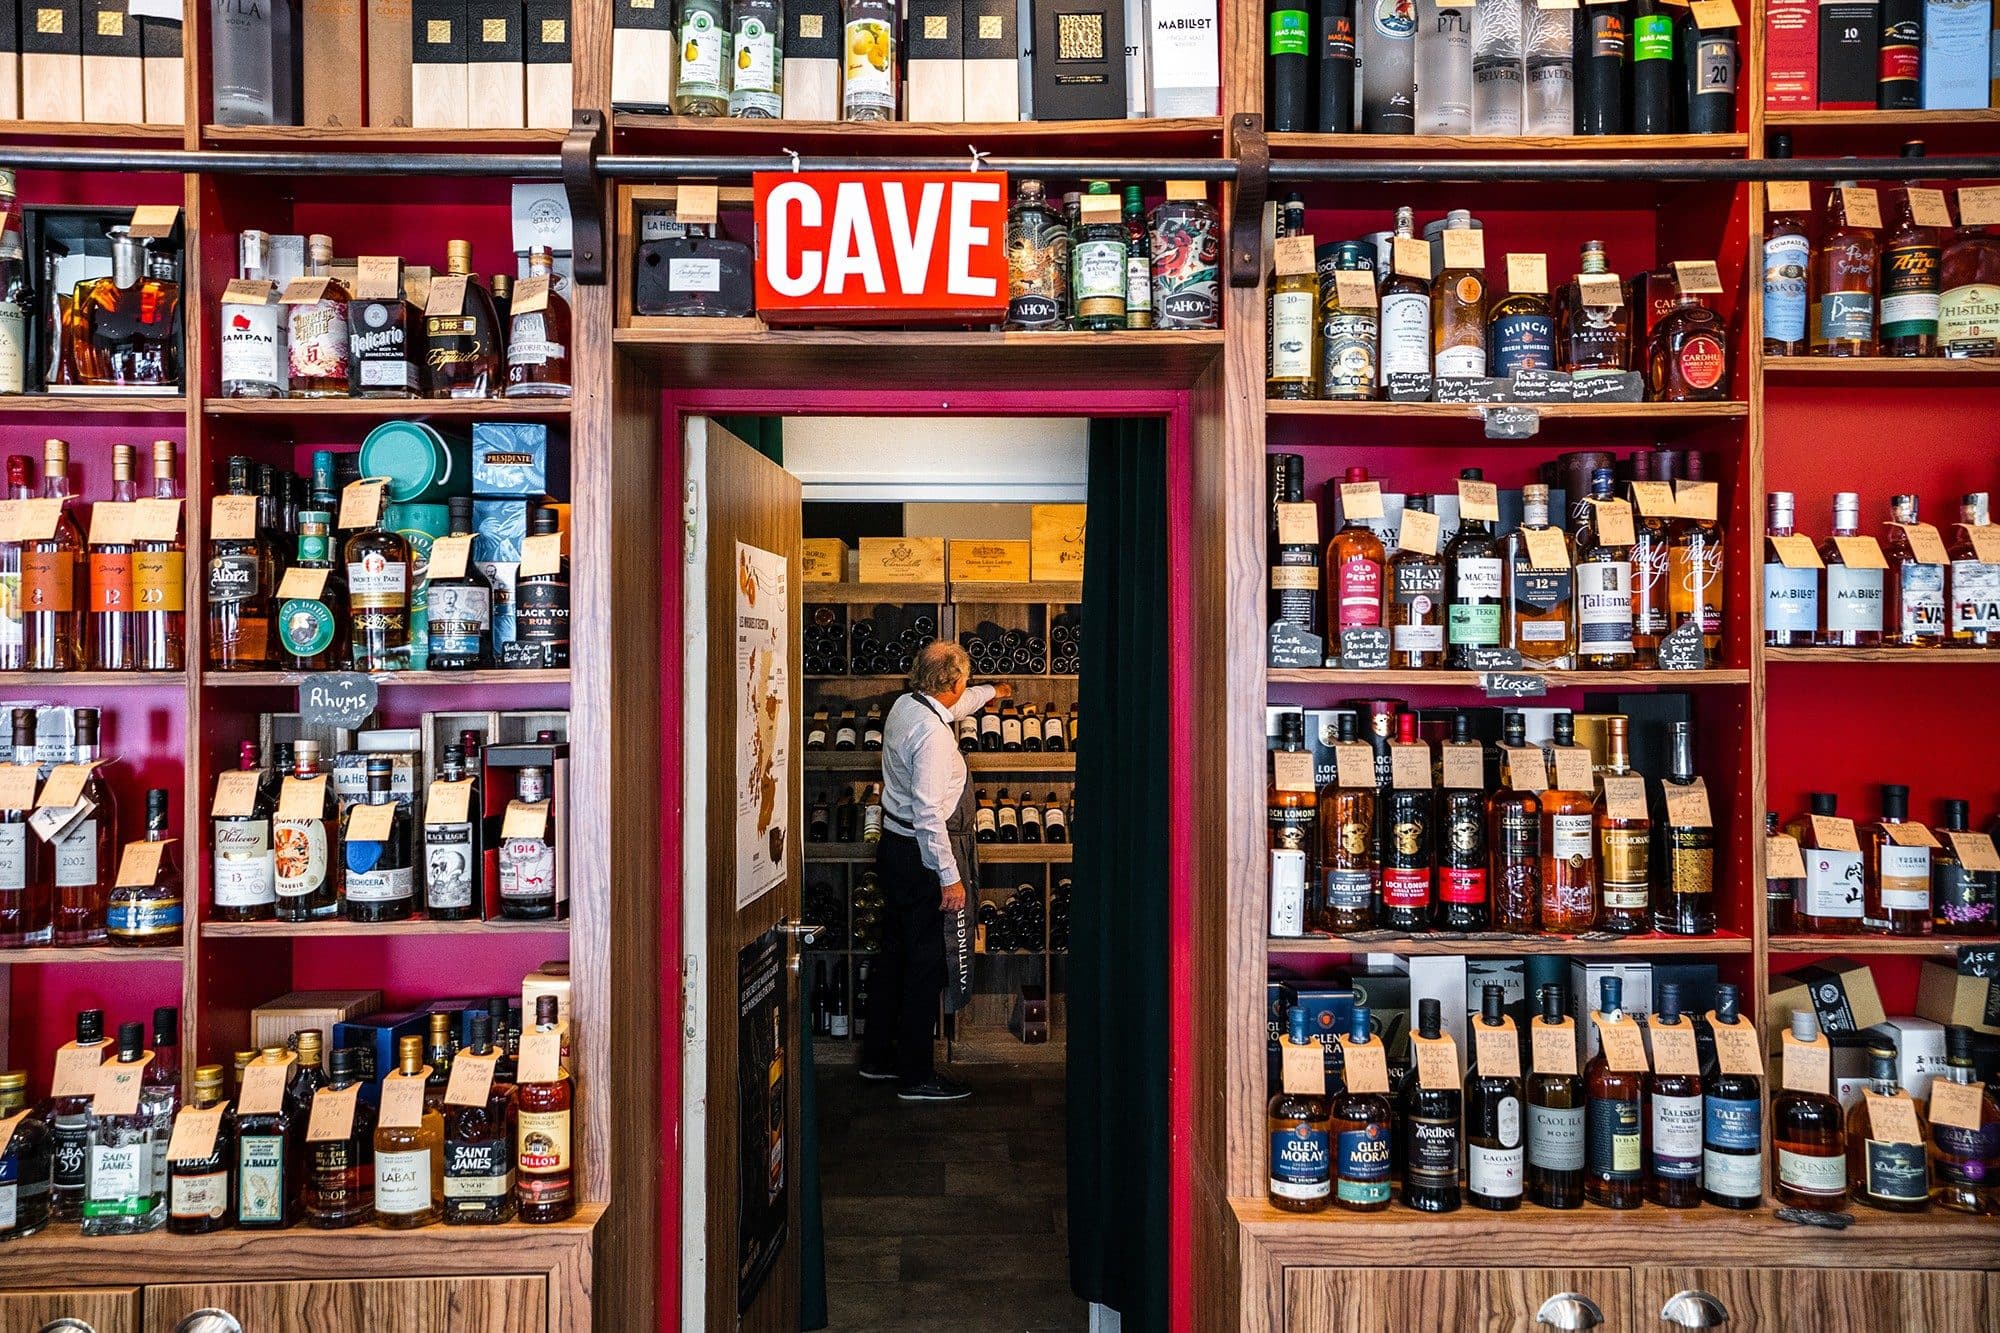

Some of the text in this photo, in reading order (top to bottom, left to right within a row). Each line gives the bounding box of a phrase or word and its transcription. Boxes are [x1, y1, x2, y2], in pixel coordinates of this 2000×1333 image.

[1158, 19, 1212, 30] MABILLOT
[1844, 27, 1859, 39] 10
[1711, 65, 1728, 83] 20
[648, 221, 658, 231] LA
[766, 181, 1001, 297] CAVE
[1892, 256, 1937, 269] Arra
[1016, 303, 1050, 316] AHOY
[1172, 299, 1206, 311] AHOY
[441, 320, 458, 330] 1995
[1504, 322, 1549, 336] HINCH
[1969, 325, 1980, 336] 10
[223, 333, 273, 343] SAMPAN
[350, 326, 404, 358] Relicario
[486, 453, 532, 464] PRESIDENTE
[383, 574, 400, 582] PARK
[1346, 572, 1377, 581] PERTH
[1400, 568, 1441, 580] ISLAY
[1400, 580, 1442, 590] MIST
[1535, 578, 1549, 589] 12
[104, 588, 121, 605] 12
[140, 587, 163, 603] 20
[1581, 594, 1631, 609] Talisma
[302, 601, 328, 622] DODO
[550, 609, 570, 617] TOT
[431, 622, 478, 634] RESIDENTE
[1493, 674, 1537, 691] ÉCOSSE
[310, 686, 366, 707] Rhums
[1318, 764, 1337, 773] LOC
[338, 775, 349, 784] LA
[1284, 809, 1315, 818] LOMOND
[1555, 819, 1575, 827] GLEN
[445, 832, 466, 840] MAGIC
[1516, 830, 1529, 841] 15
[513, 844, 536, 854] 1914
[62, 857, 86, 866] 2002
[231, 872, 242, 882] 13
[1332, 883, 1351, 891] LOCH
[1385, 881, 1402, 889] LOCH
[957, 908, 967, 994] TAITTINGER
[1661, 1107, 1700, 1117] TALISKE
[1537, 1114, 1566, 1126] CAOL
[1287, 1140, 1319, 1151] GLEN
[1357, 1140, 1386, 1151] GLEN
[102, 1152, 132, 1162] SAINT
[454, 1147, 492, 1159] SAINT
[1280, 1150, 1324, 1163] MORAY
[1350, 1151, 1390, 1163] MORAY
[60, 1156, 81, 1173] 59
[100, 1161, 133, 1171] JAMES
[451, 1157, 492, 1171] JAMES
[521, 1155, 558, 1167] DILLON
[381, 1171, 417, 1183] LABAT
[1505, 1167, 1514, 1178] 8
[318, 1190, 347, 1201] VSOP
[1368, 1188, 1379, 1197] 12
